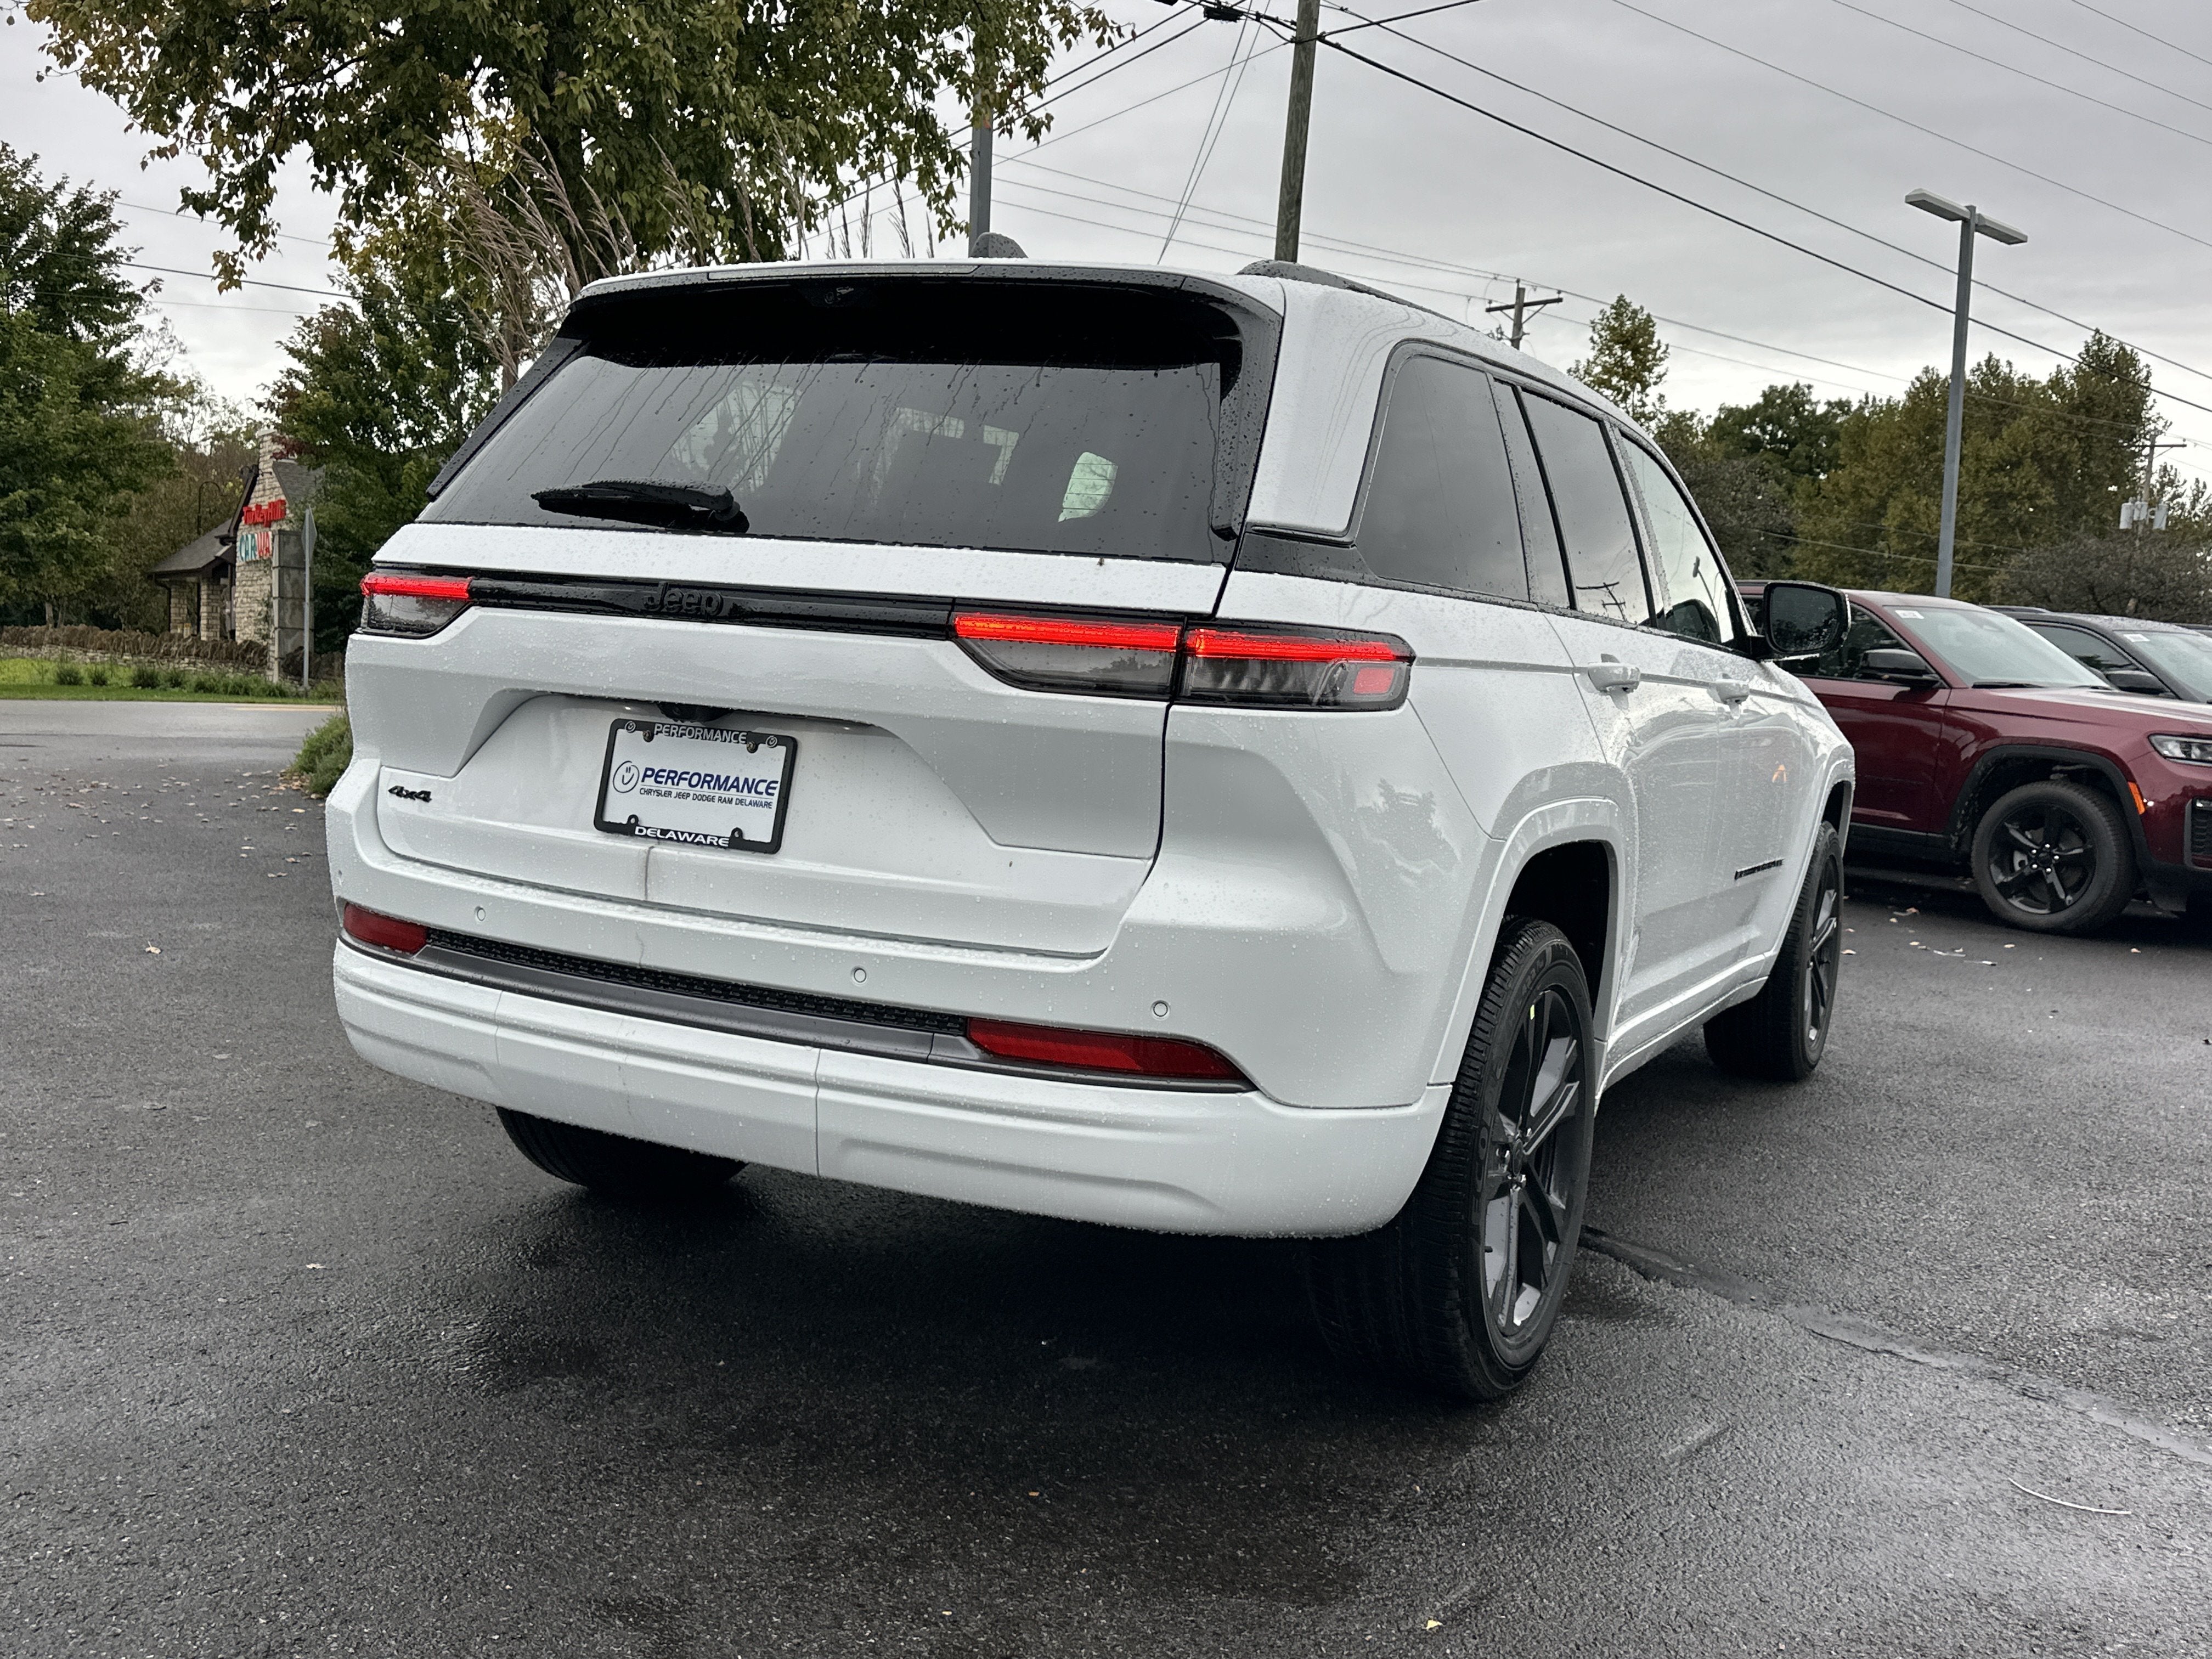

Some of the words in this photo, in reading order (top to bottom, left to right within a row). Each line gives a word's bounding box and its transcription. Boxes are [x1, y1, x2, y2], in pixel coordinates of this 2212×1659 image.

[240, 534, 257, 561] CAR
[258, 532, 270, 558] WA
[644, 582, 723, 616] Jeep
[654, 723, 747, 744] PERFORMANCE
[641, 767, 778, 797] PERFORMANCE
[388, 785, 432, 803] 4x4
[639, 788, 672, 799] CHRYSLER
[674, 792, 691, 800] JEEP
[692, 793, 715, 803] DODGE
[717, 796, 733, 805] RAM
[735, 798, 772, 809] DELAWARE
[634, 826, 731, 847] DELAWARE
